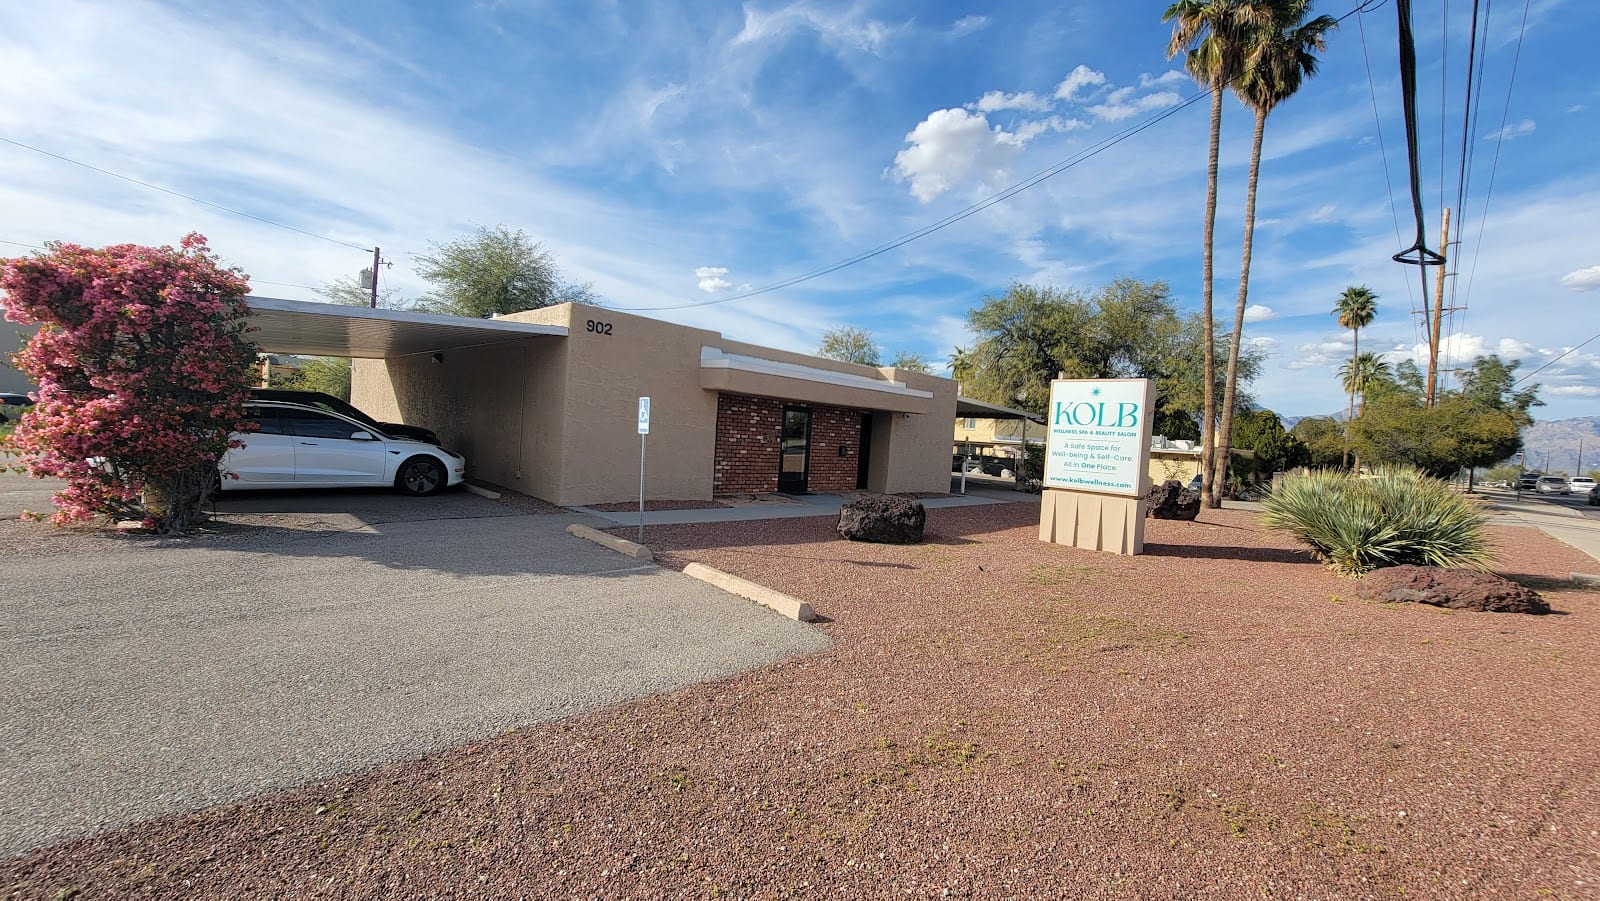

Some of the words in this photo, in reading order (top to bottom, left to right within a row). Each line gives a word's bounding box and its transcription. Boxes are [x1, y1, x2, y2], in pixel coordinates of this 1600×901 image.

[586, 319, 613, 336] 902
[1054, 401, 1139, 428] KOLB
[1070, 442, 1085, 450] Safe
[1086, 443, 1110, 452] Space
[1051, 450, 1089, 460] Well-being
[1050, 476, 1132, 489] www.kolbwellness.com
